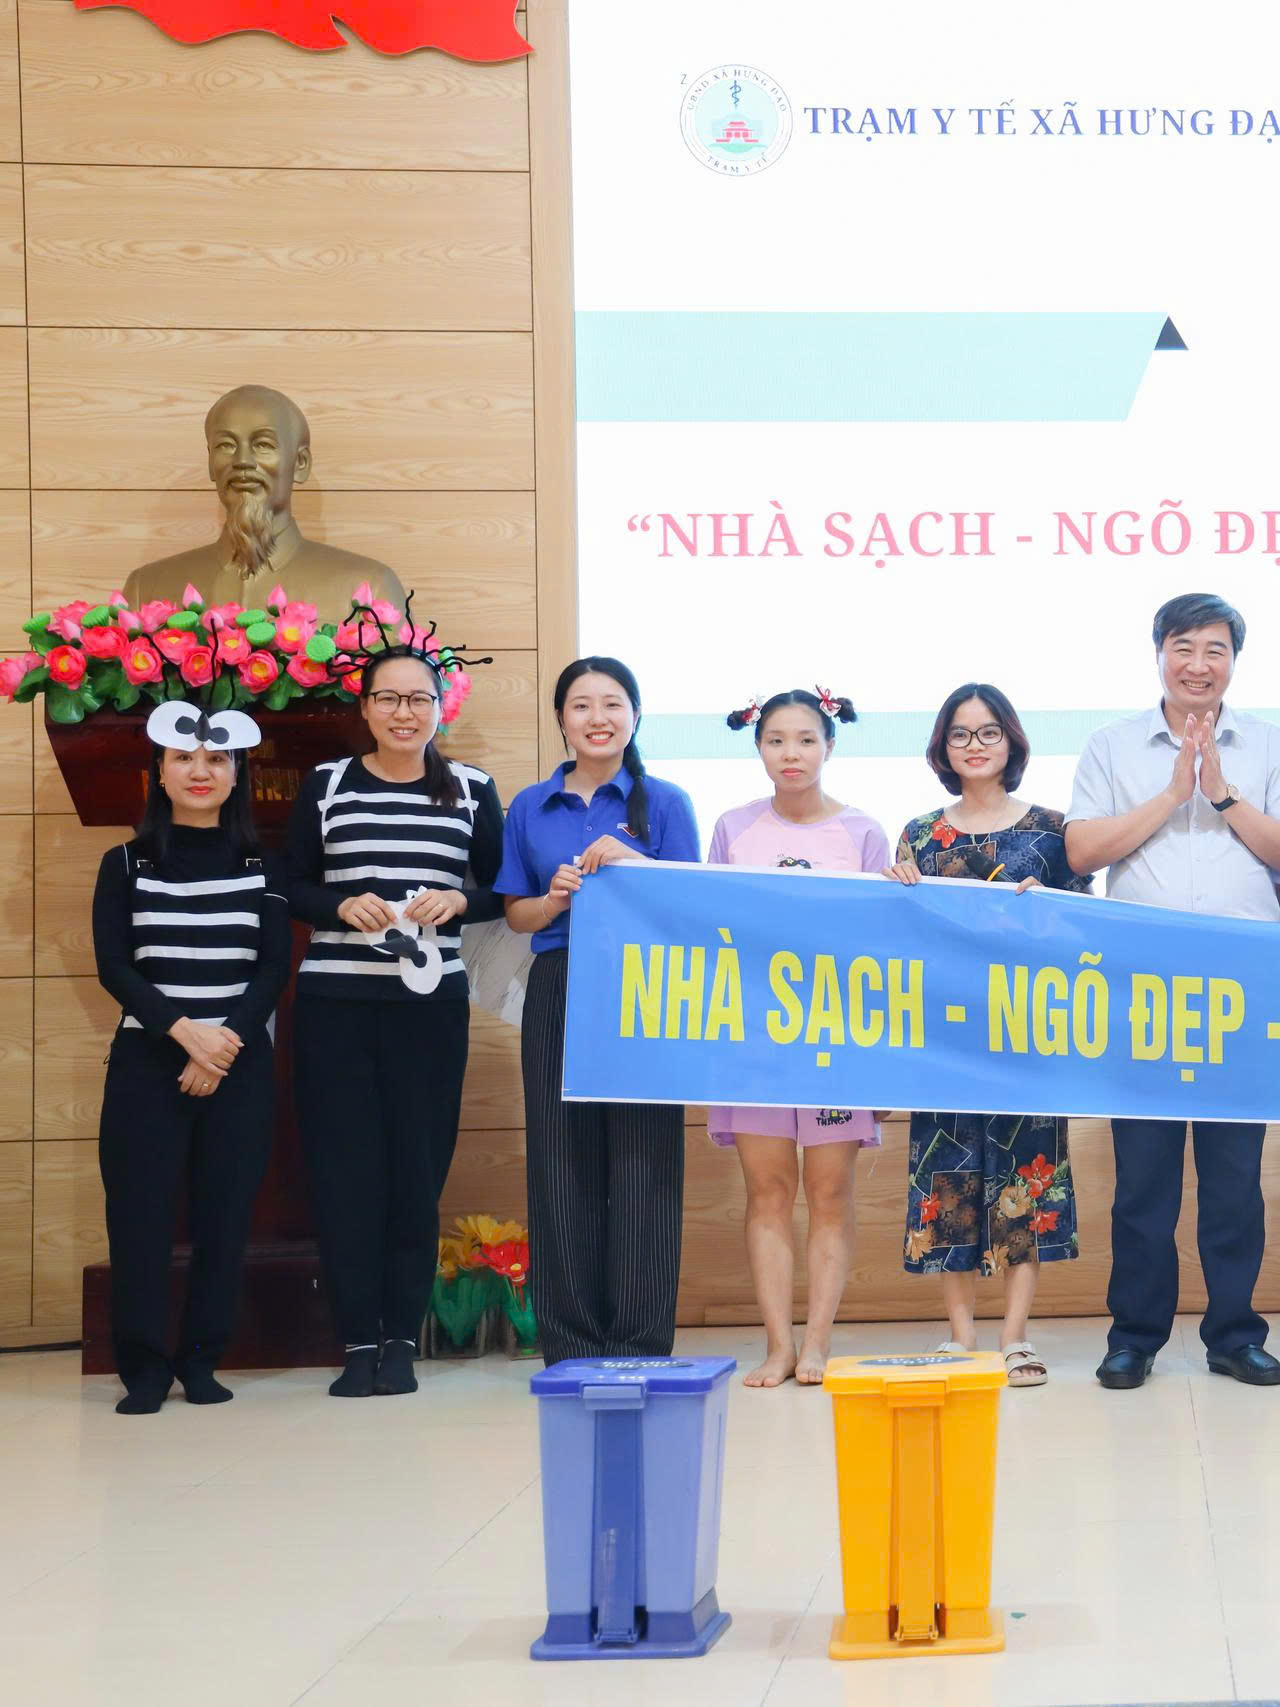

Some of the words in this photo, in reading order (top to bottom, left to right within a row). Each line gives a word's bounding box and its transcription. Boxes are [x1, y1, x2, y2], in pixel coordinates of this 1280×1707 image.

[804, 107, 917, 143] TRẠM
[931, 108, 956, 135] Y
[968, 99, 1017, 135] TẾ
[1030, 101, 1083, 136] XÃ
[1097, 107, 1214, 136] HƯNG
[627, 500, 801, 557] “NHÀ
[823, 511, 993, 568] SẠCH
[1055, 498, 1191, 556] NGÕ
[620, 926, 745, 1041] NHÀ
[766, 950, 925, 1068] SẠCH
[988, 951, 1109, 1059] NGÕ
[1129, 972, 1245, 1082] ĐẸP
